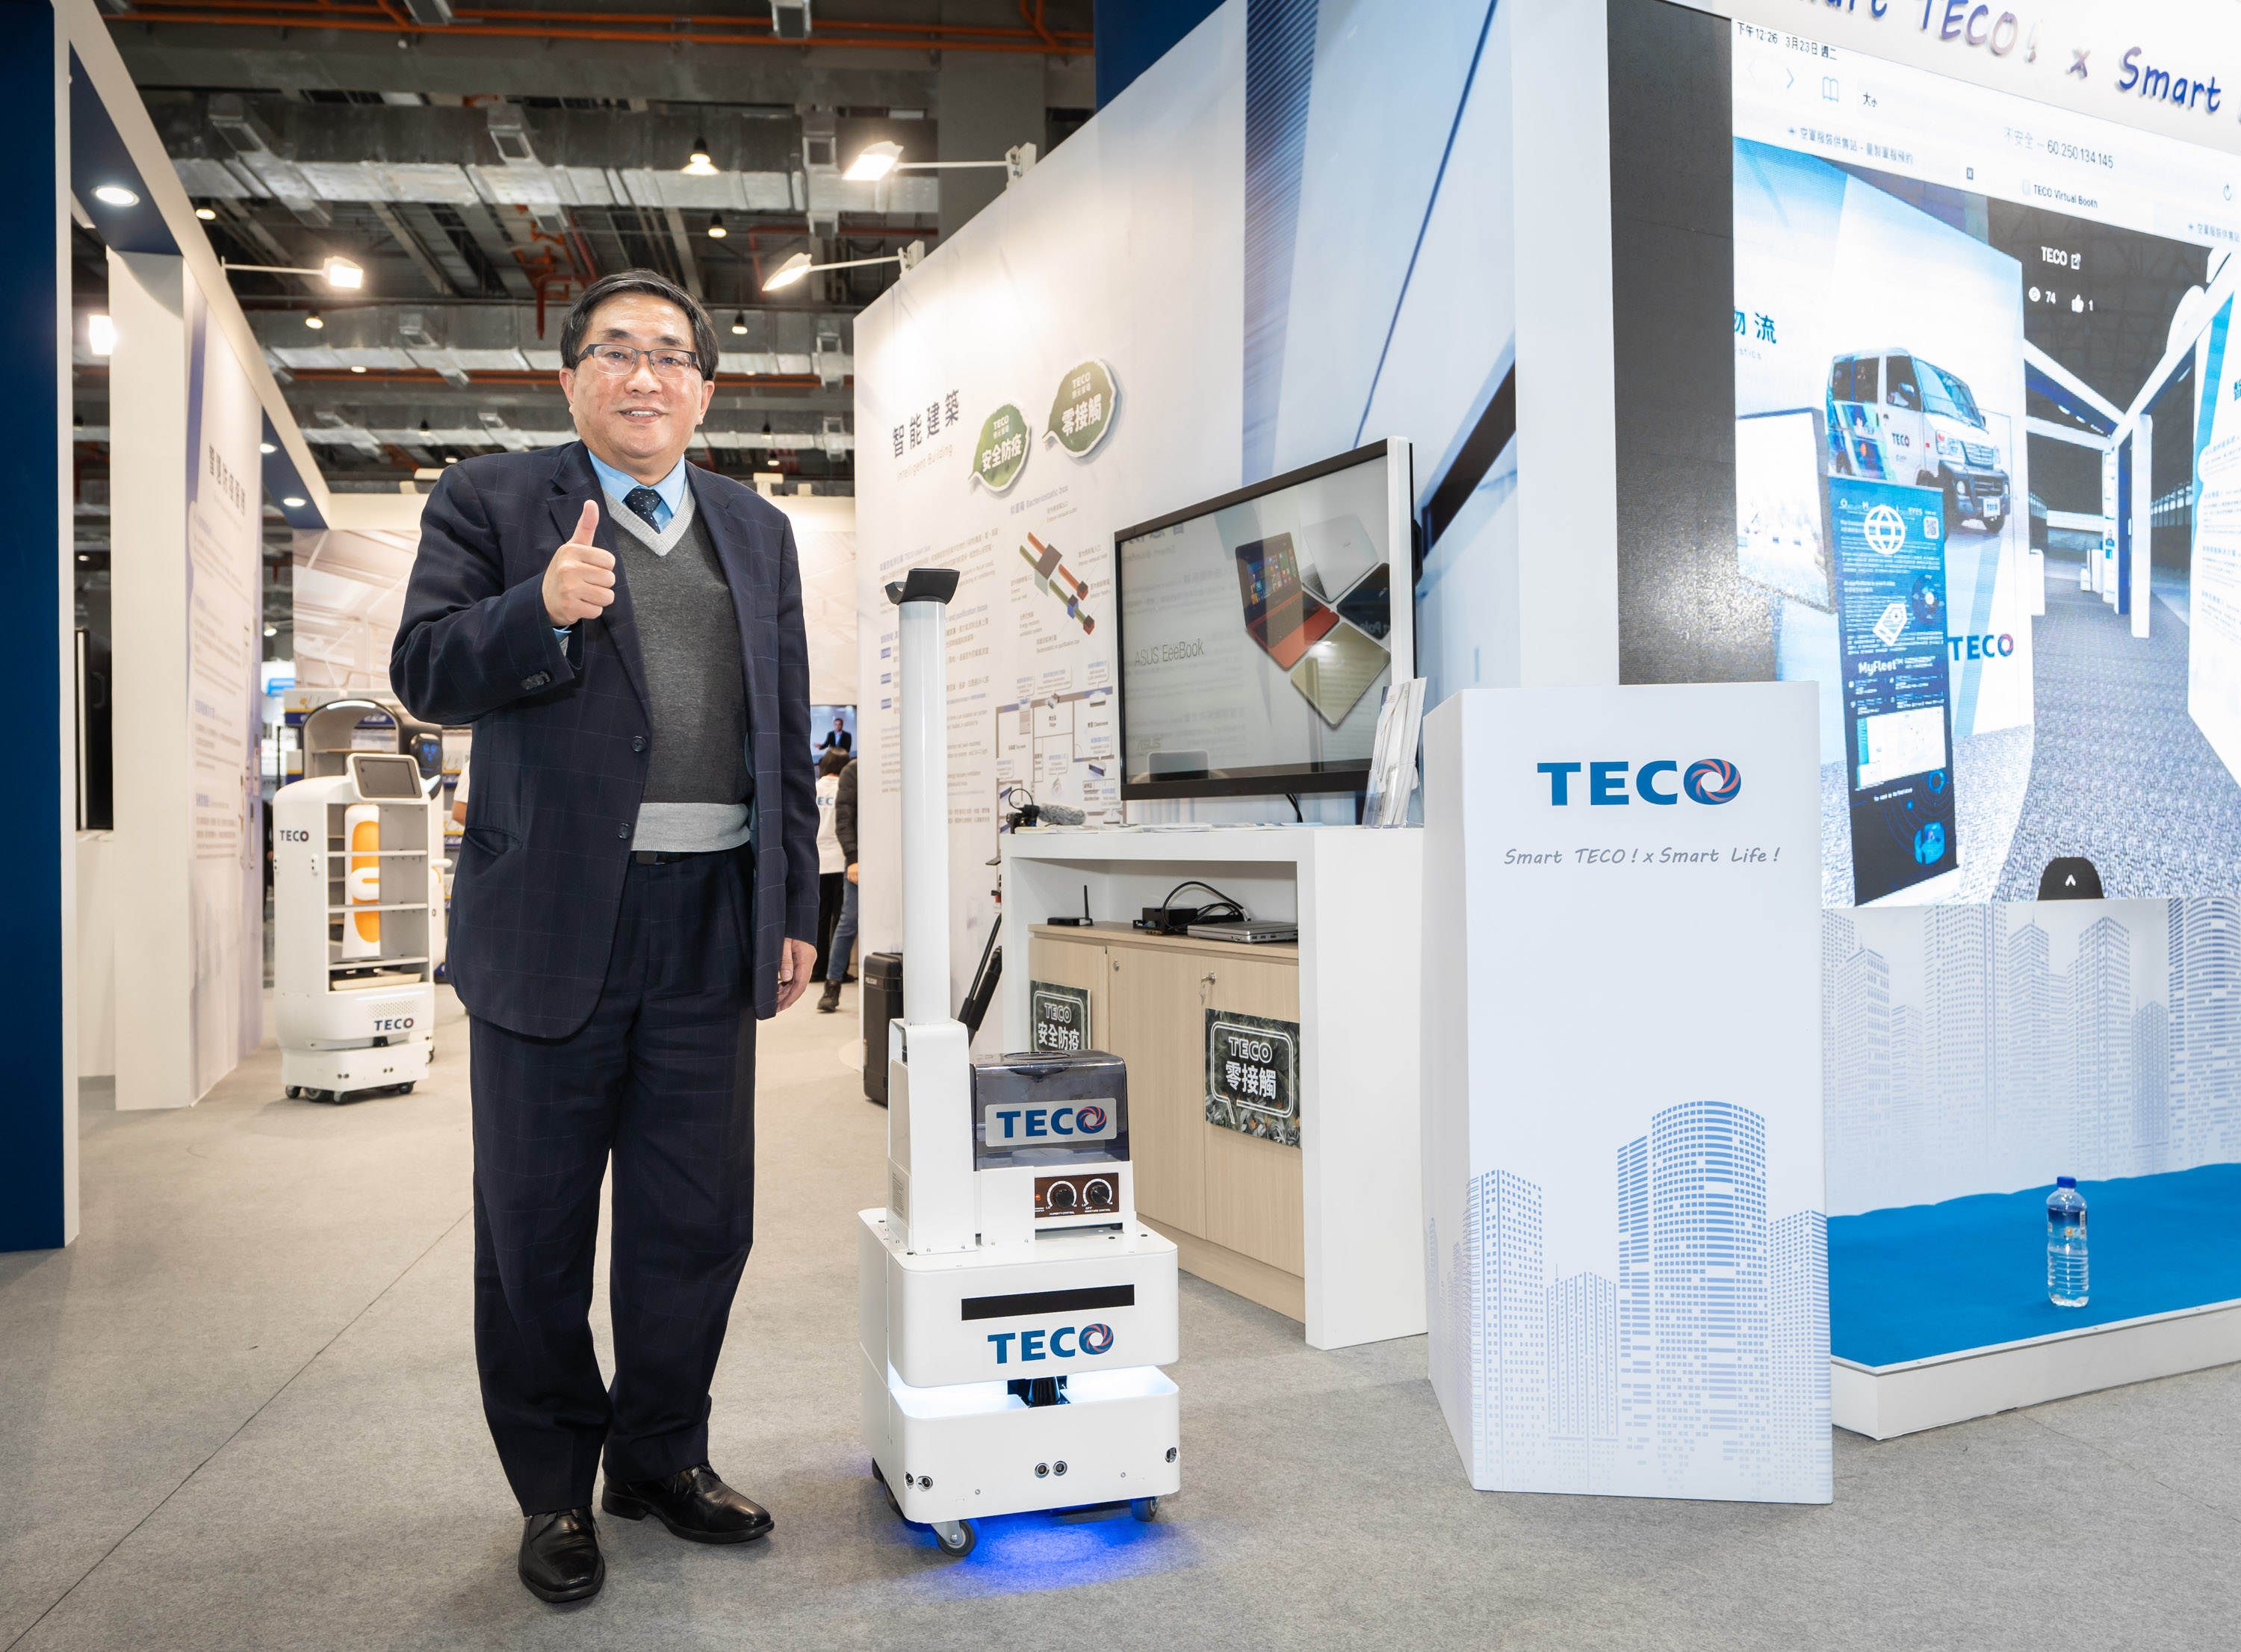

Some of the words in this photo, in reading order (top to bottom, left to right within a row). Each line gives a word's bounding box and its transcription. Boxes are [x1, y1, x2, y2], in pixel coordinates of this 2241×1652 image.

[2068, 48, 2091, 78] x
[2118, 46, 2222, 112] Smart
[2033, 184, 2052, 198] TECO
[2054, 190, 2077, 204] Virtual
[2078, 196, 2098, 208] Booth
[2041, 246, 2068, 266] TECO
[2045, 291, 2056, 304] 74
[1073, 371, 1091, 388] TECO
[893, 389, 959, 459] 智能建築
[994, 414, 1009, 430] TECO
[1062, 393, 1101, 436] 零接觸
[982, 433, 1021, 472] 安全防疫
[1891, 432, 1910, 447] TECO
[1135, 647, 1159, 667] ASUS
[1162, 638, 1204, 662] EeeBook
[1947, 633, 2014, 661] TECO
[1537, 759, 1741, 806] TECO
[817, 796, 834, 806] EC
[279, 830, 309, 842] TECO
[1504, 848, 1563, 865] Smart
[1659, 847, 1719, 863] Smart
[374, 1017, 414, 1031] TECO
[1044, 1002, 1071, 1023] TECO
[1038, 1021, 1079, 1050] 安全防疫
[1229, 1037, 1272, 1063] TECO
[1225, 1061, 1276, 1099] 零接觸
[996, 1106, 1106, 1138] TECO
[988, 1323, 1114, 1364] TECO
